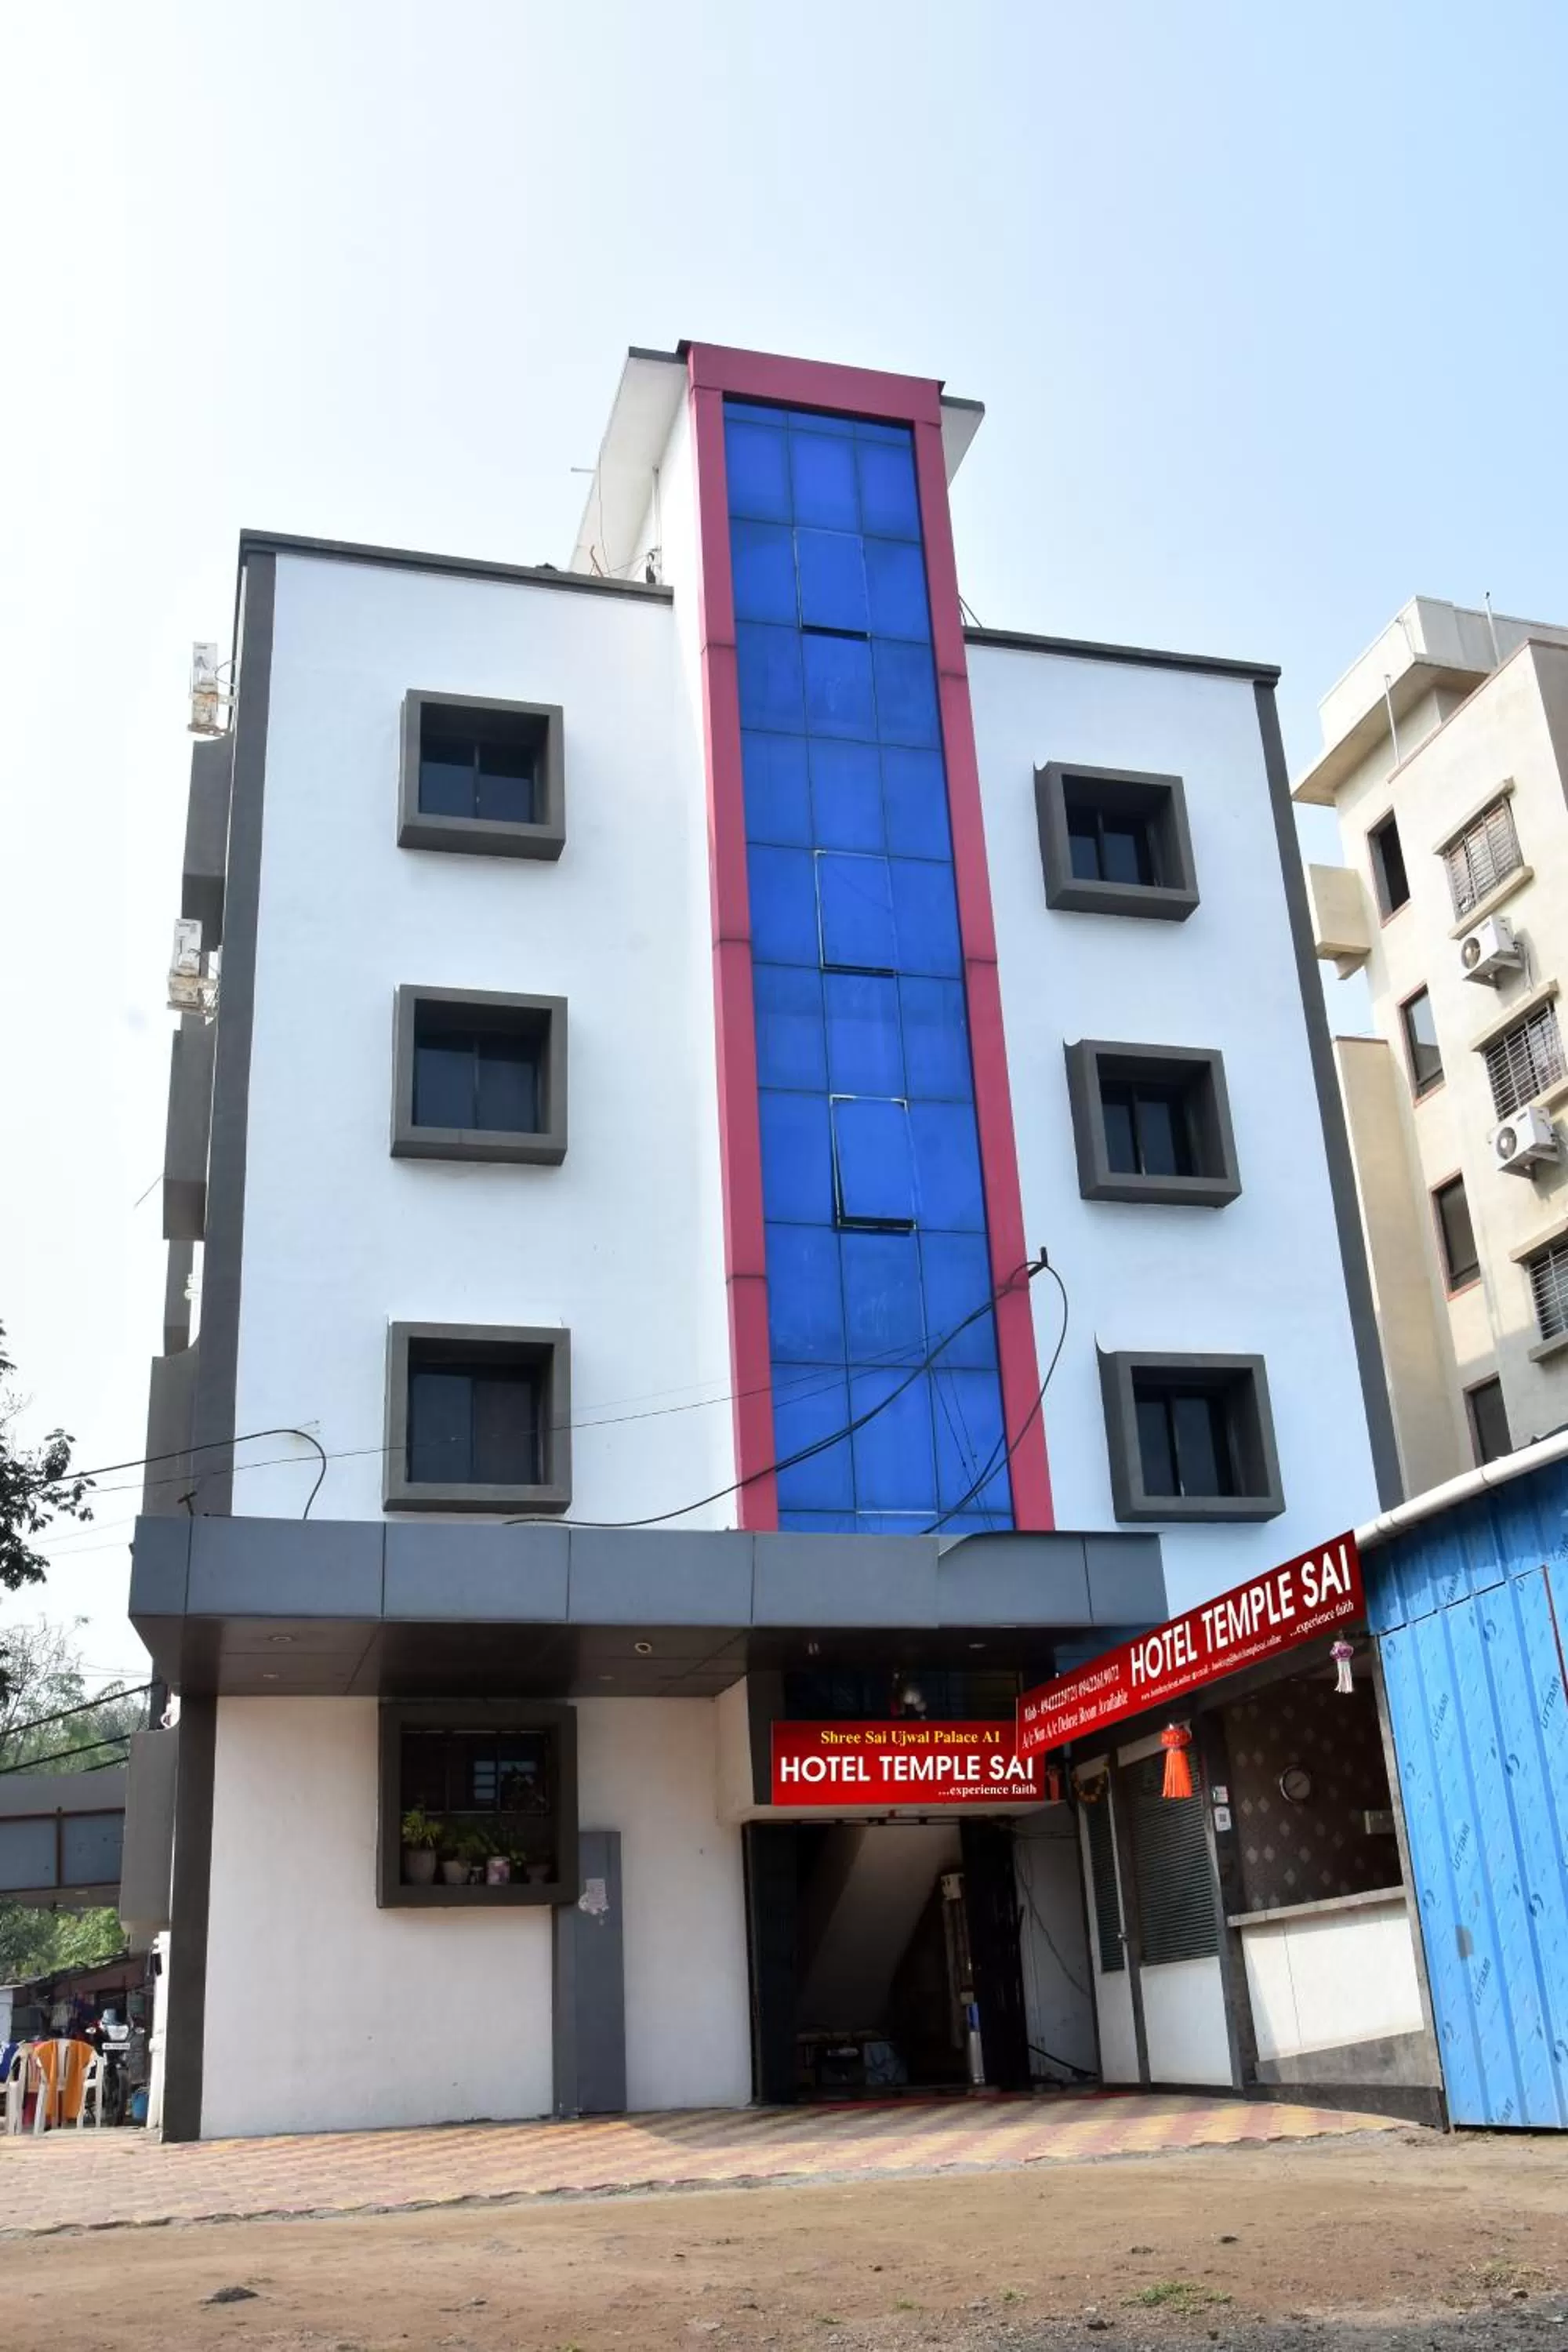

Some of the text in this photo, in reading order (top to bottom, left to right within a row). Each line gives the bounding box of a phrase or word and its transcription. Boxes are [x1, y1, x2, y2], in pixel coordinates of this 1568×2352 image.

[1130, 1543, 1352, 1686] HOTEL TEMPLE SAI
[1334, 1600, 1354, 1619] faith
[1541, 1675, 1560, 1730] UTTAM
[821, 1730, 862, 1744] Shree
[865, 1730, 887, 1744] Sai
[891, 1730, 930, 1747] Ujwal
[934, 1730, 979, 1744] Palace
[780, 1755, 1033, 1782] HOTEL TEMPLE SAI
[1011, 1783, 1037, 1795] faith
